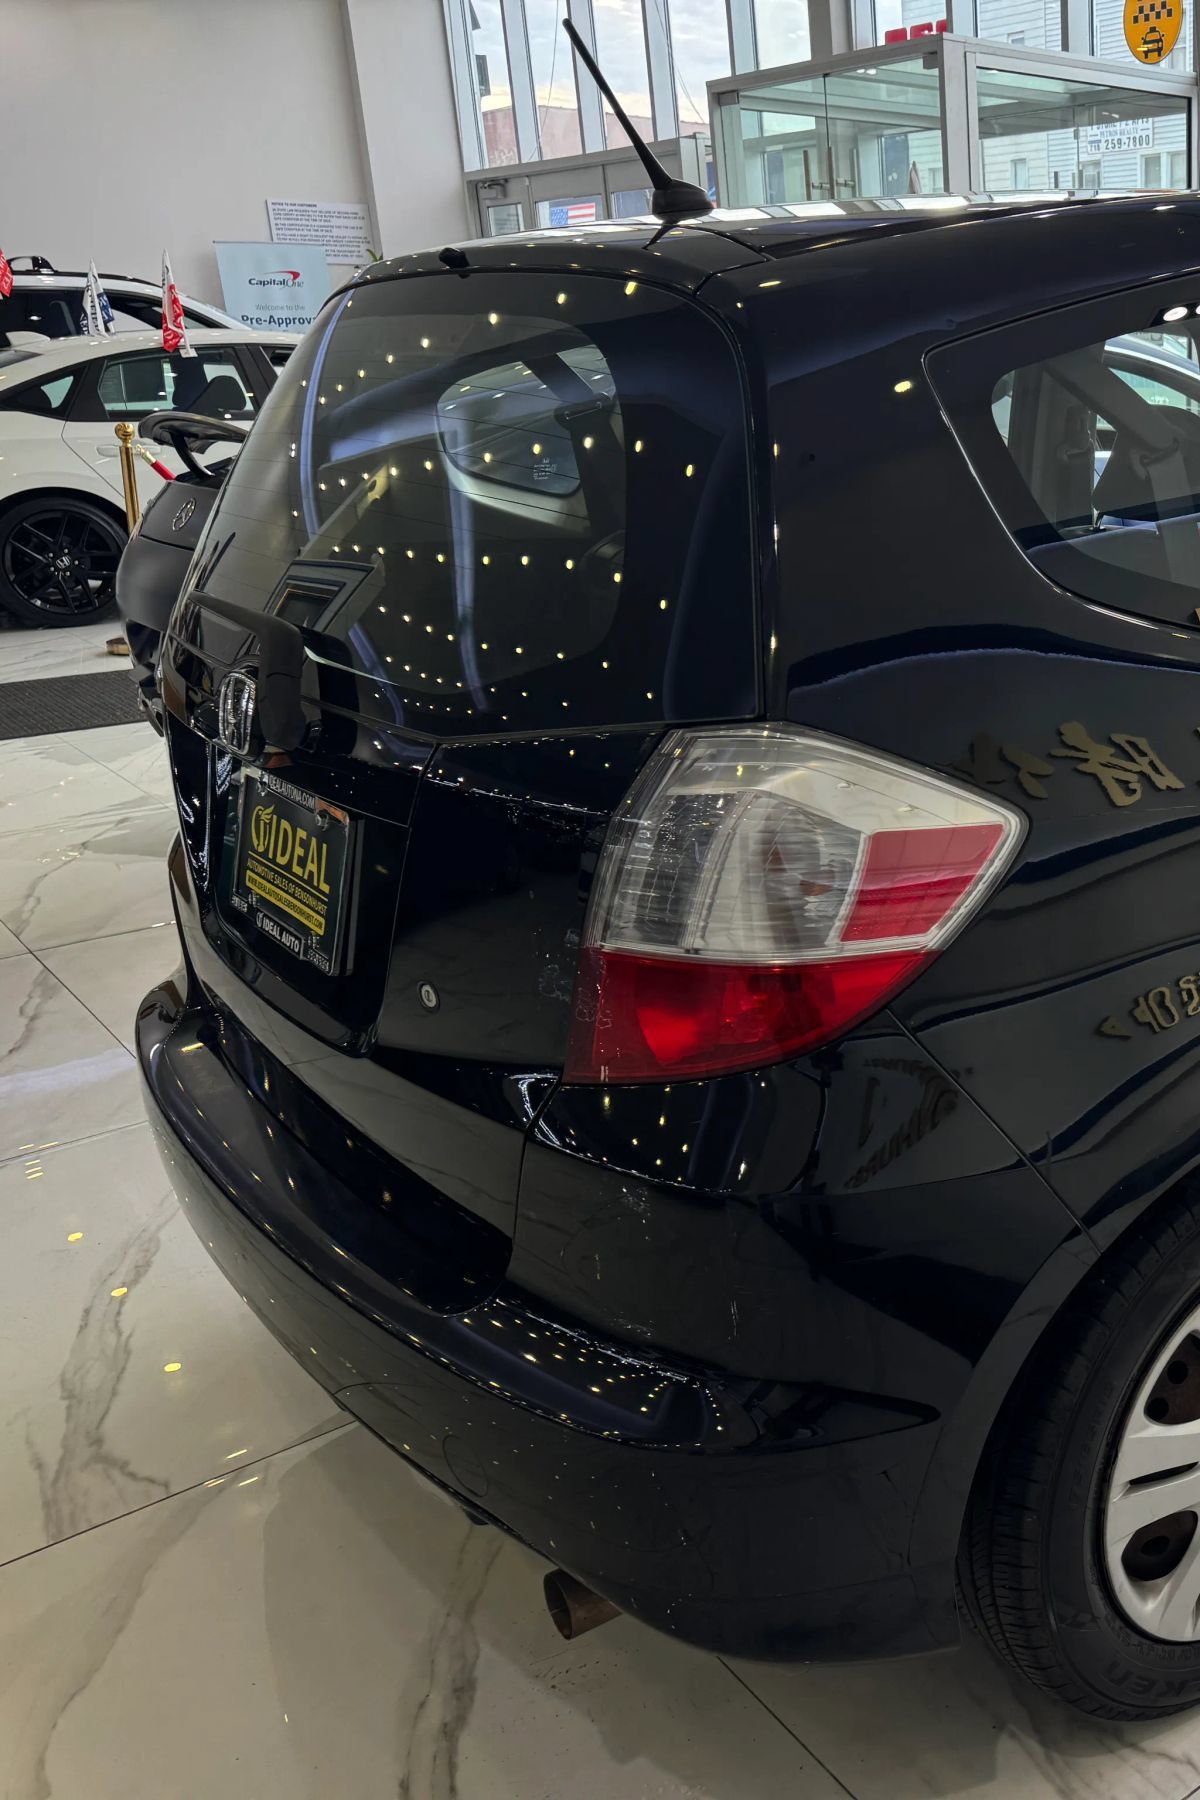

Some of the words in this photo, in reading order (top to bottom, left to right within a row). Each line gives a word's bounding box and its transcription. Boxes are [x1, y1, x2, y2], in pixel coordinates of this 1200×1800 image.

[268, 814, 331, 893] IDEAL
[262, 917, 281, 939] IDEAL
[281, 930, 300, 953] AUTO
